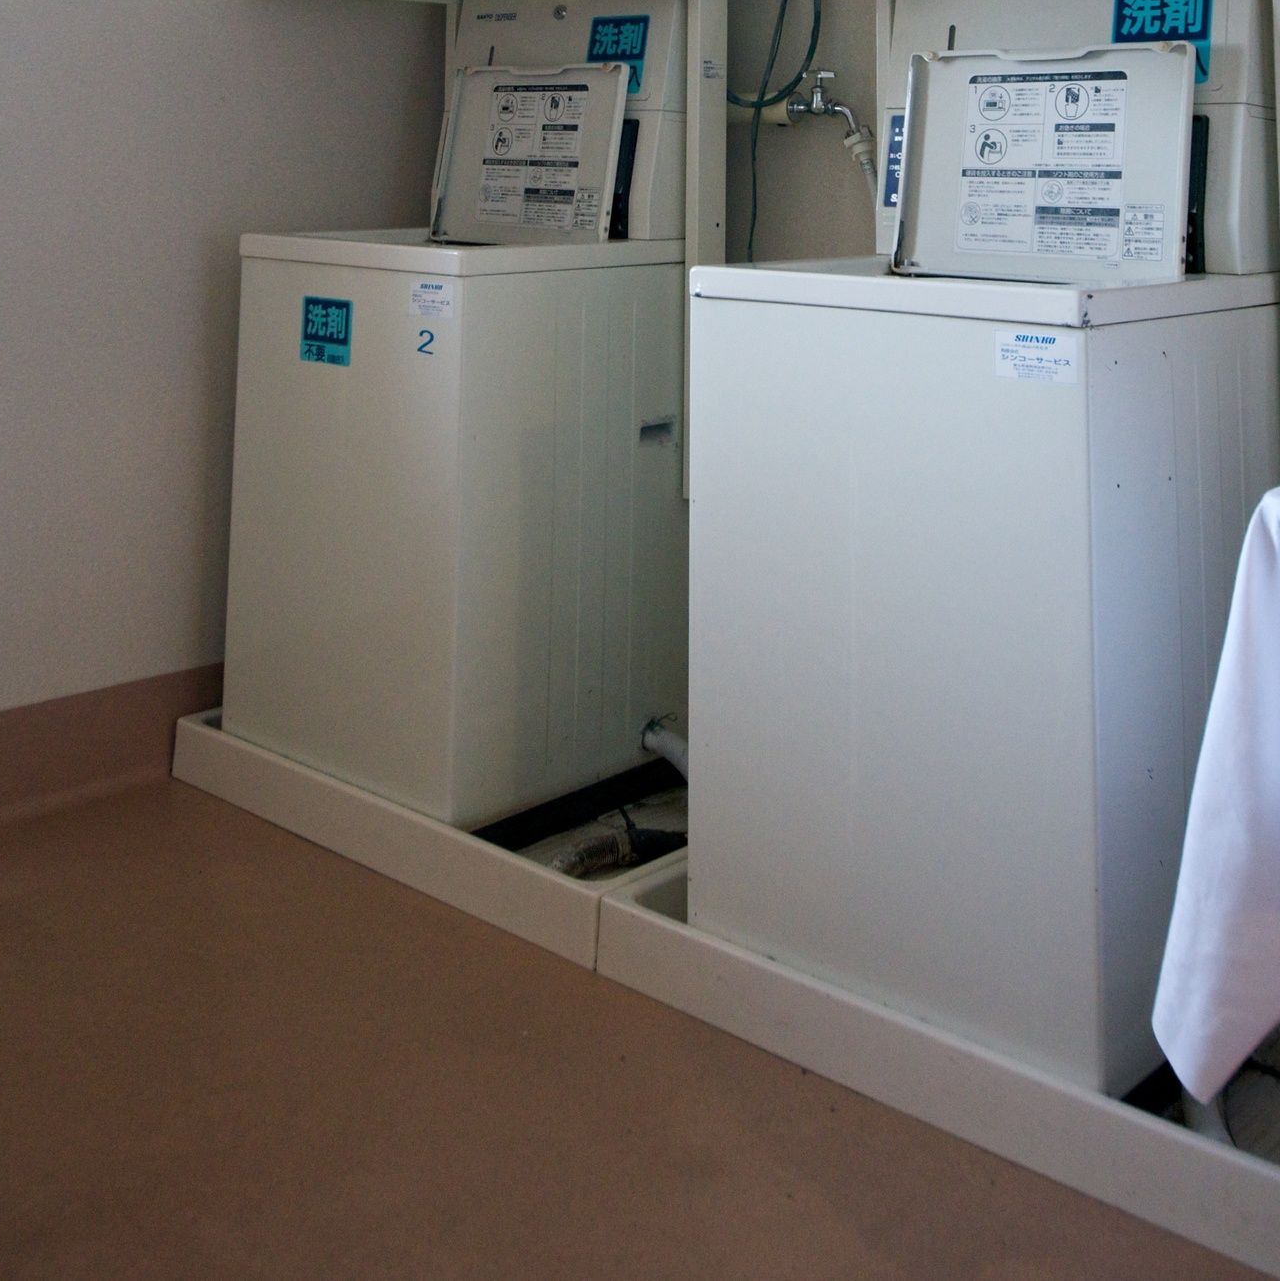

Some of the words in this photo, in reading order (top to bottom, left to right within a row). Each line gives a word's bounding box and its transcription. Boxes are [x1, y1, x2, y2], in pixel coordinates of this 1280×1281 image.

[593, 22, 644, 55] 洗剤
[1049, 84, 1055, 93] 2
[970, 125, 976, 133] 3
[307, 304, 347, 339] 洗剤
[417, 329, 435, 355] 2
[1014, 334, 1056, 345] SHINKO
[1001, 353, 1071, 367] シンコーサービス
